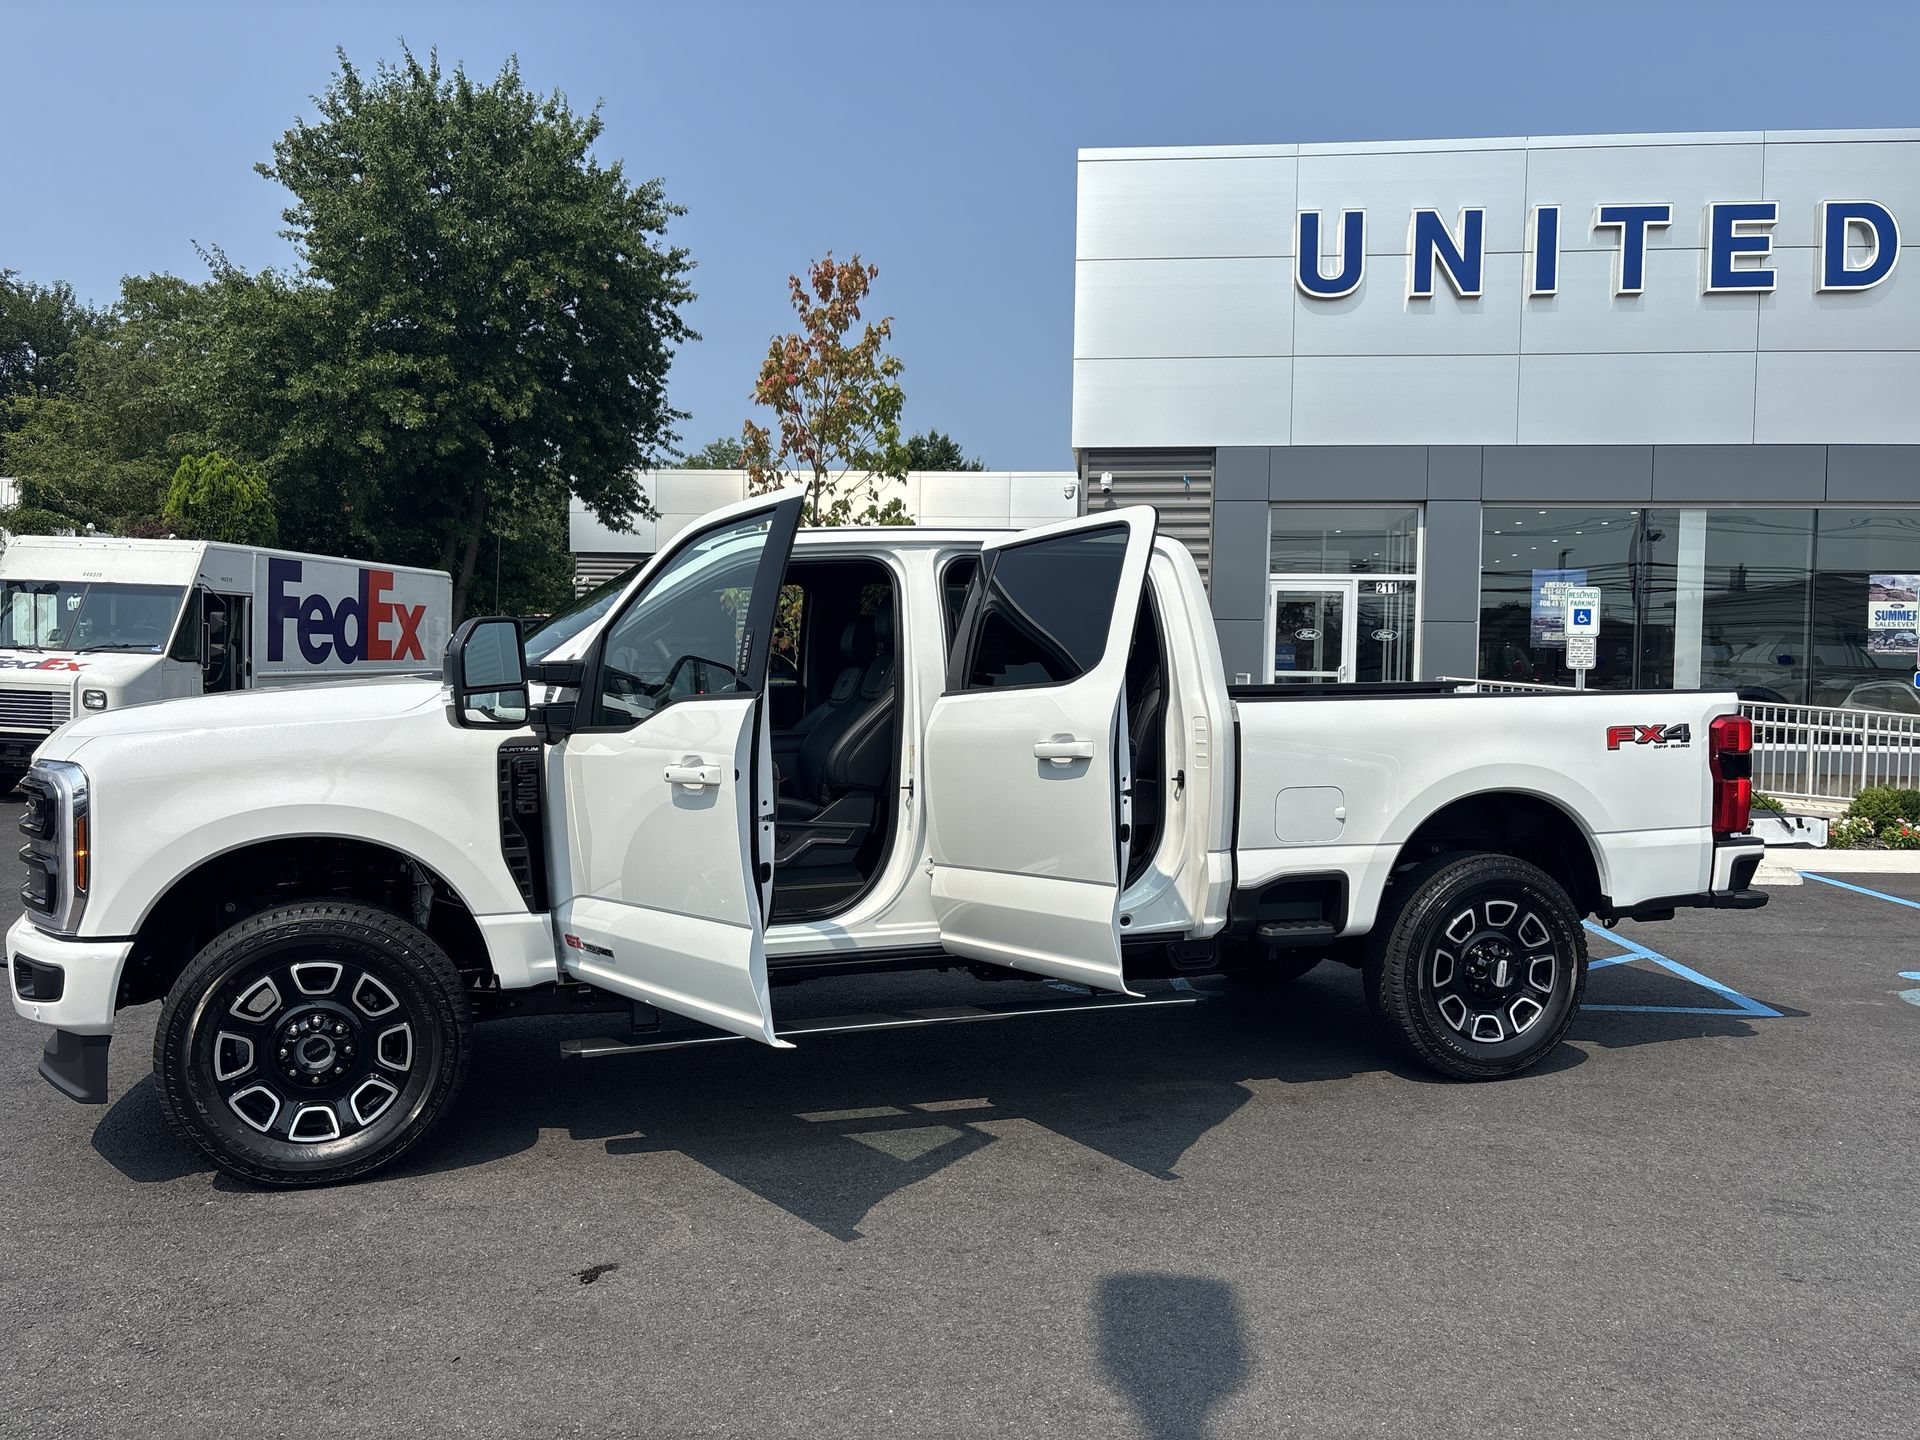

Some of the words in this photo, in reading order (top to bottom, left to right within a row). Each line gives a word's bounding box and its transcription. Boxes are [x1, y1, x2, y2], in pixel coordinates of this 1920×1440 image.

[1296, 200, 1902, 299] UNITED
[1377, 582, 1397, 594] 211
[1568, 591, 1598, 599] RESERVED
[267, 557, 427, 665] FedEx
[1607, 723, 1691, 750] FX4
